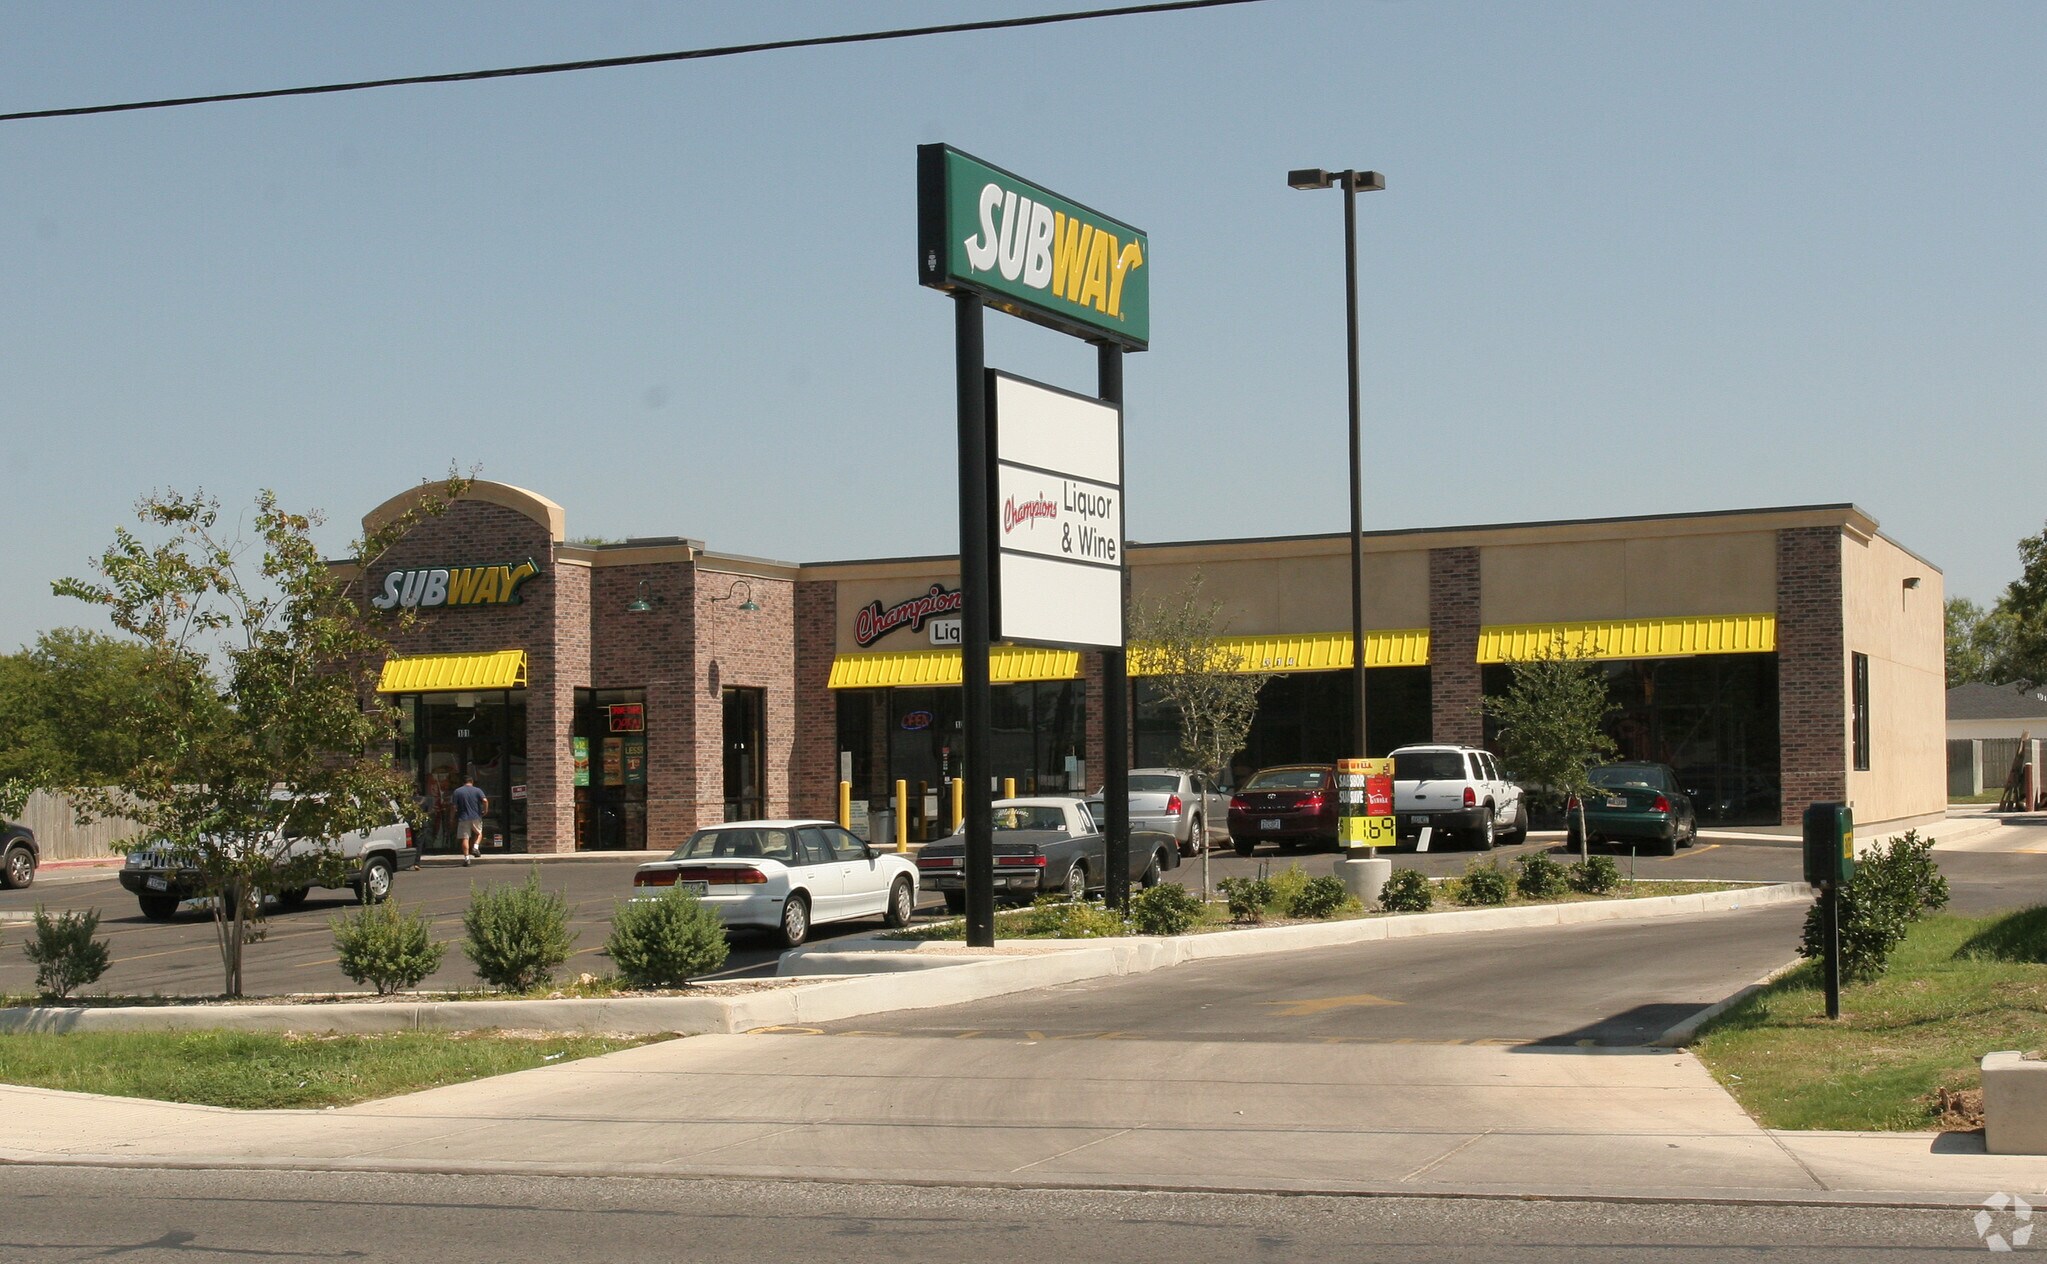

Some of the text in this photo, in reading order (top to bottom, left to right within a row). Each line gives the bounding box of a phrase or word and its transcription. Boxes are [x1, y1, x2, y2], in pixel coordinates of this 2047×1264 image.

[964, 183, 1143, 317] SUBWAY
[1004, 491, 1057, 534] Champions
[1063, 480, 1112, 521] Liquor
[1061, 522, 1116, 560] & Wine
[372, 560, 537, 609] SUBWAY
[856, 587, 961, 644] Champion
[935, 623, 960, 642] Liq
